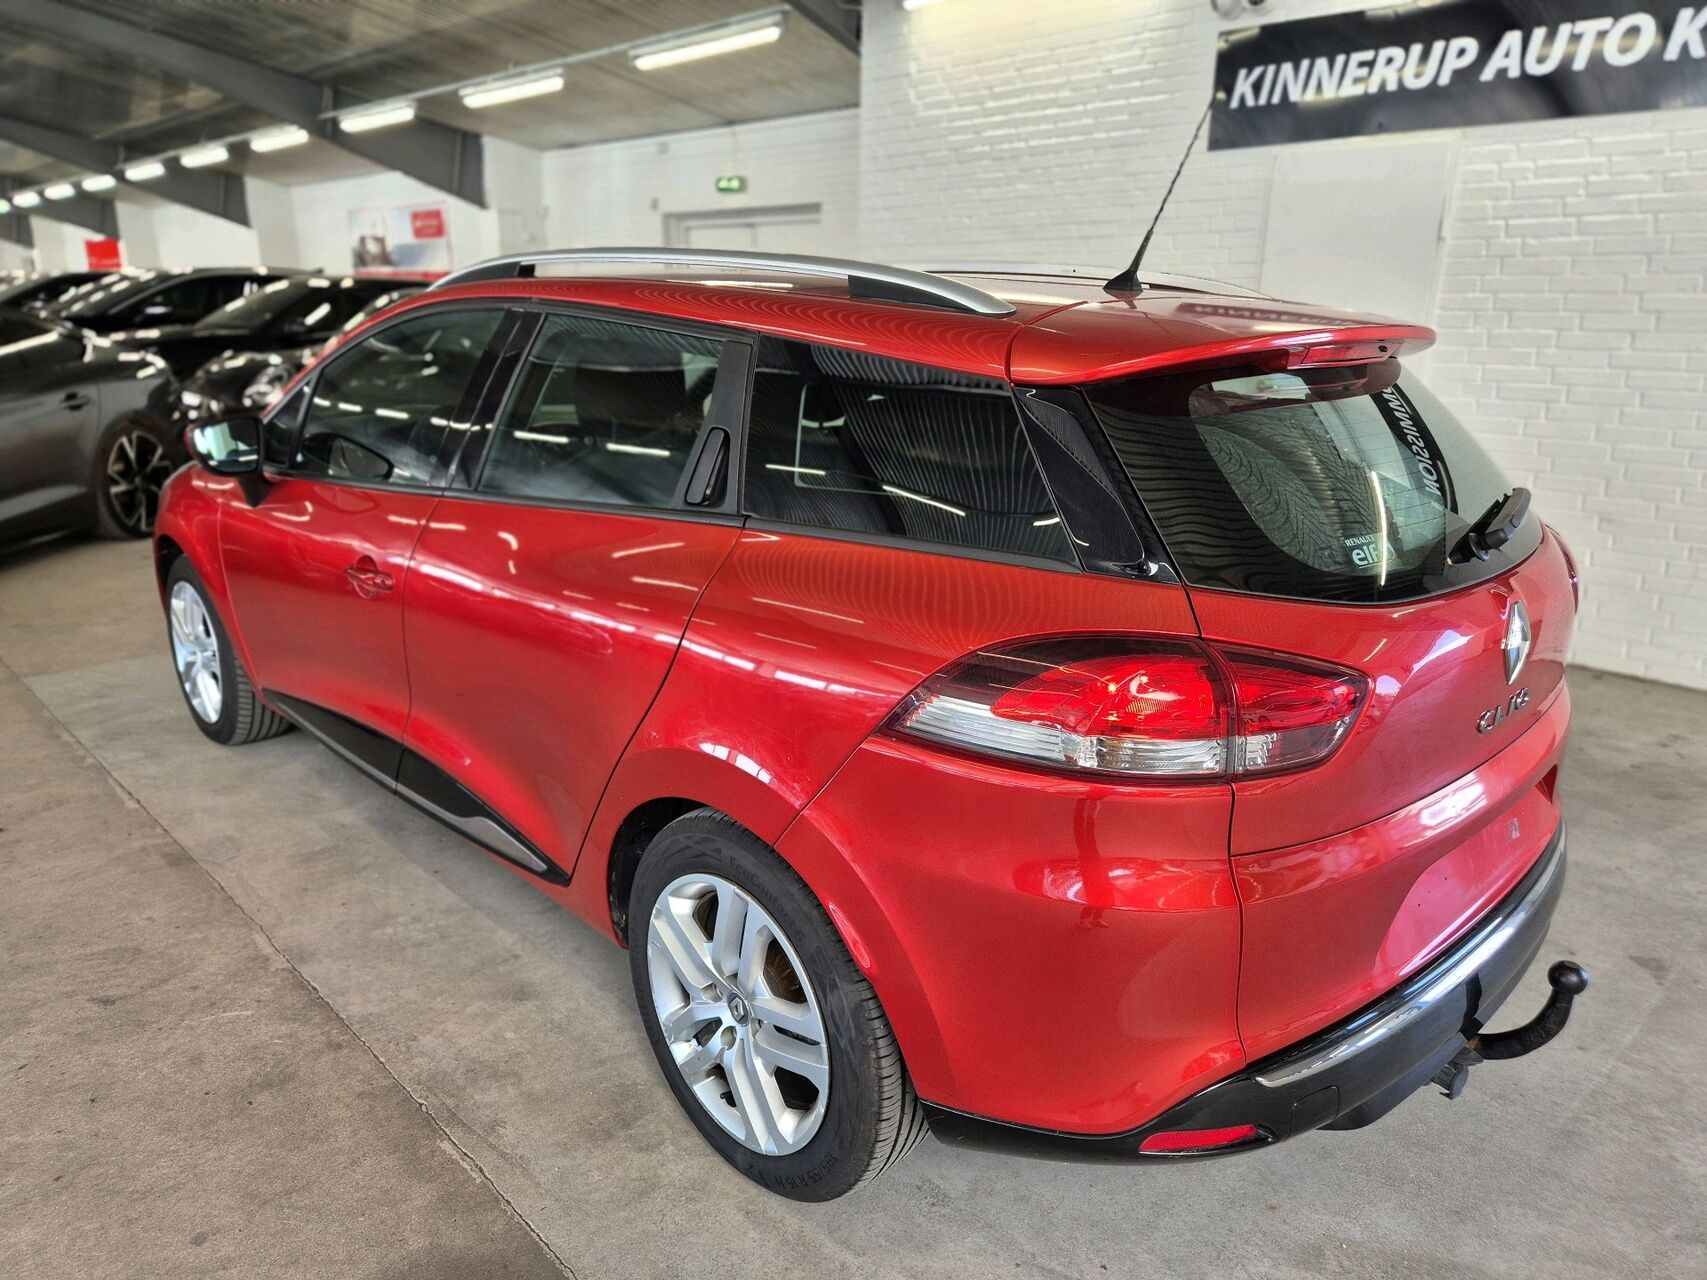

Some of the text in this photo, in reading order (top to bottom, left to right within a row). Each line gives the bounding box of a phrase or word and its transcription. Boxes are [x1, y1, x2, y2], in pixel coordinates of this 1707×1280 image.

[1229, 36, 1479, 110] KINNERUP
[1479, 11, 1656, 83] AUTO
[1344, 534, 1375, 547] RENAULT
[1352, 543, 1379, 566] elf
